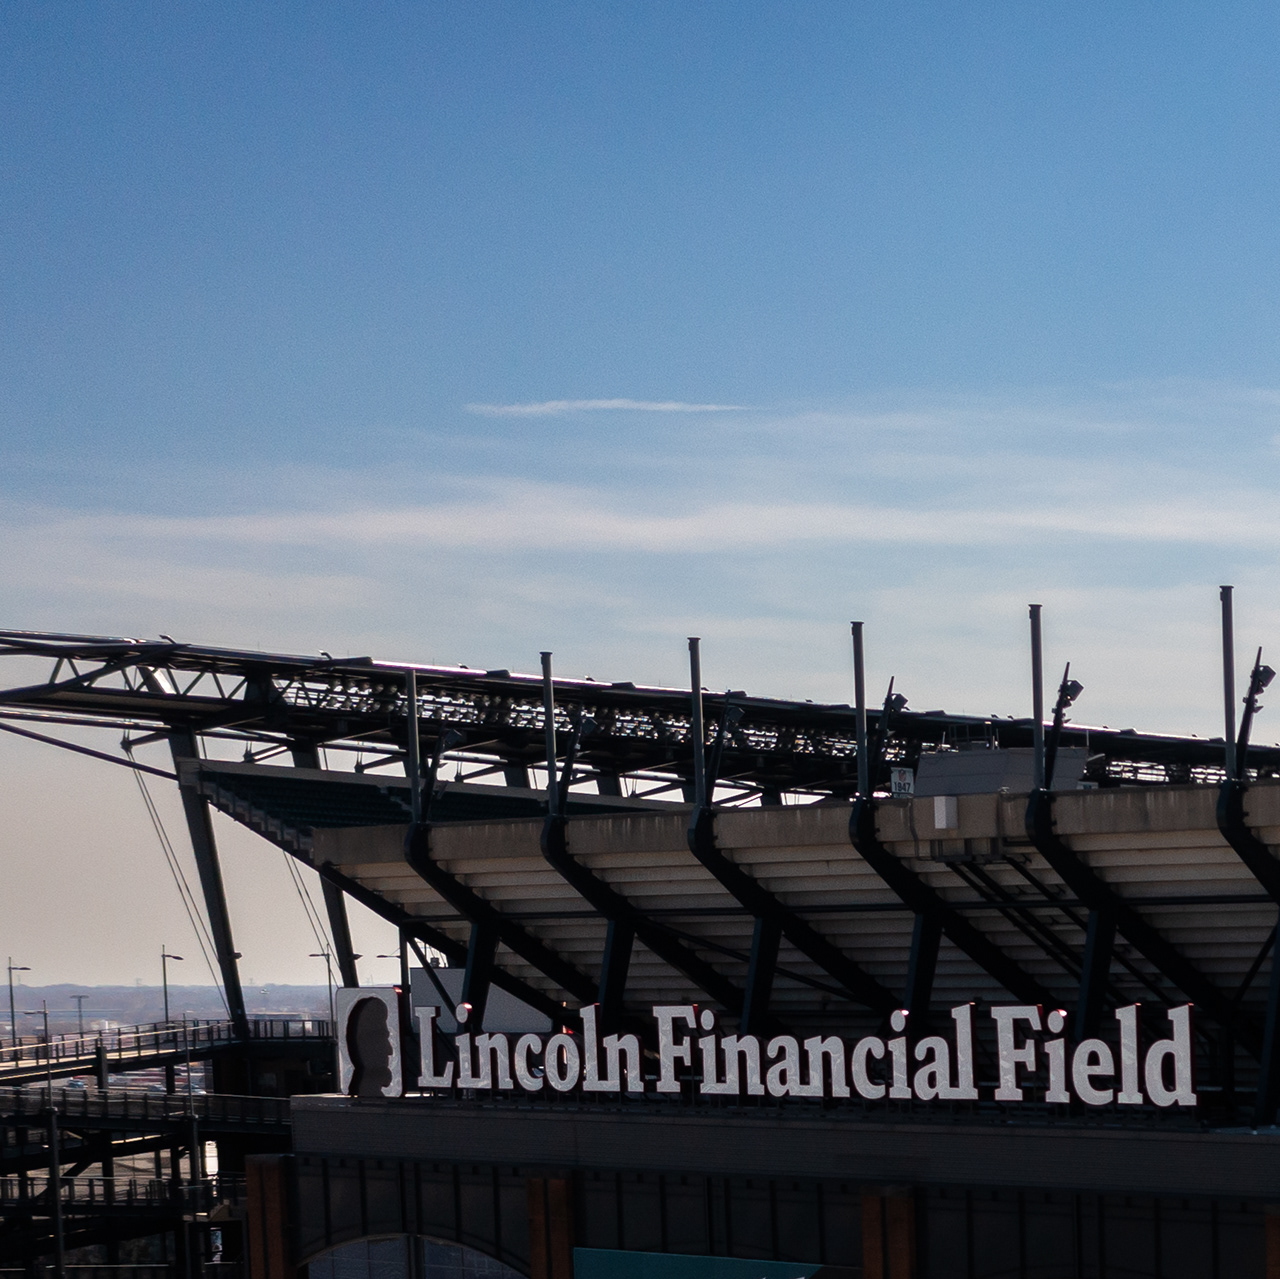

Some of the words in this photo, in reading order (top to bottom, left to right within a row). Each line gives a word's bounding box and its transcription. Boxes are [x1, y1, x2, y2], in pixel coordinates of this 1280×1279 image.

[413, 1002, 645, 1092] Lincoln
[652, 1002, 979, 1100] Financial
[990, 1002, 1198, 1107] Field
